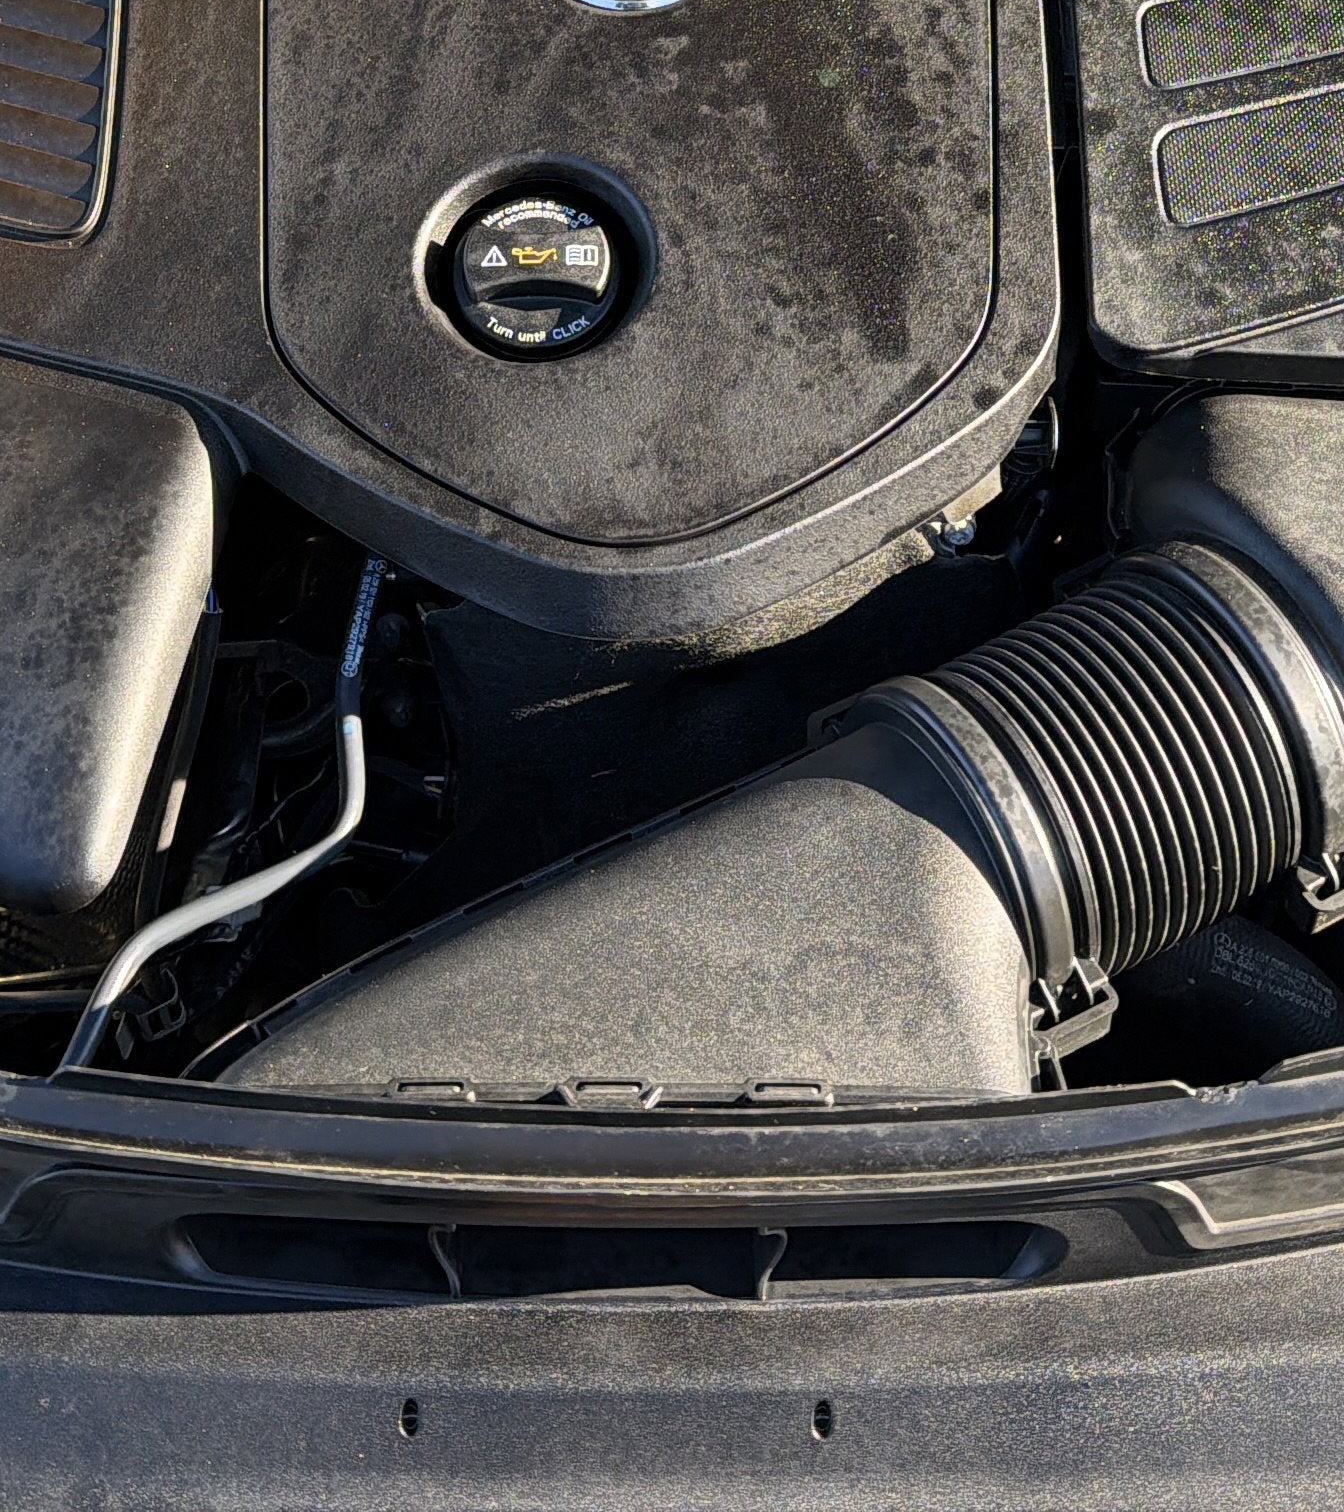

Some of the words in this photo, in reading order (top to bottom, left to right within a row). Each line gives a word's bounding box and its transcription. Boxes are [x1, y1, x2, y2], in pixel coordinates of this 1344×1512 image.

[481, 200, 576, 228] Mercedes-Benz
[578, 212, 594, 226] Oil
[497, 210, 580, 230] recommended
[485, 317, 514, 339] Turn
[517, 330, 546, 343] until
[552, 315, 590, 340] CLICK
